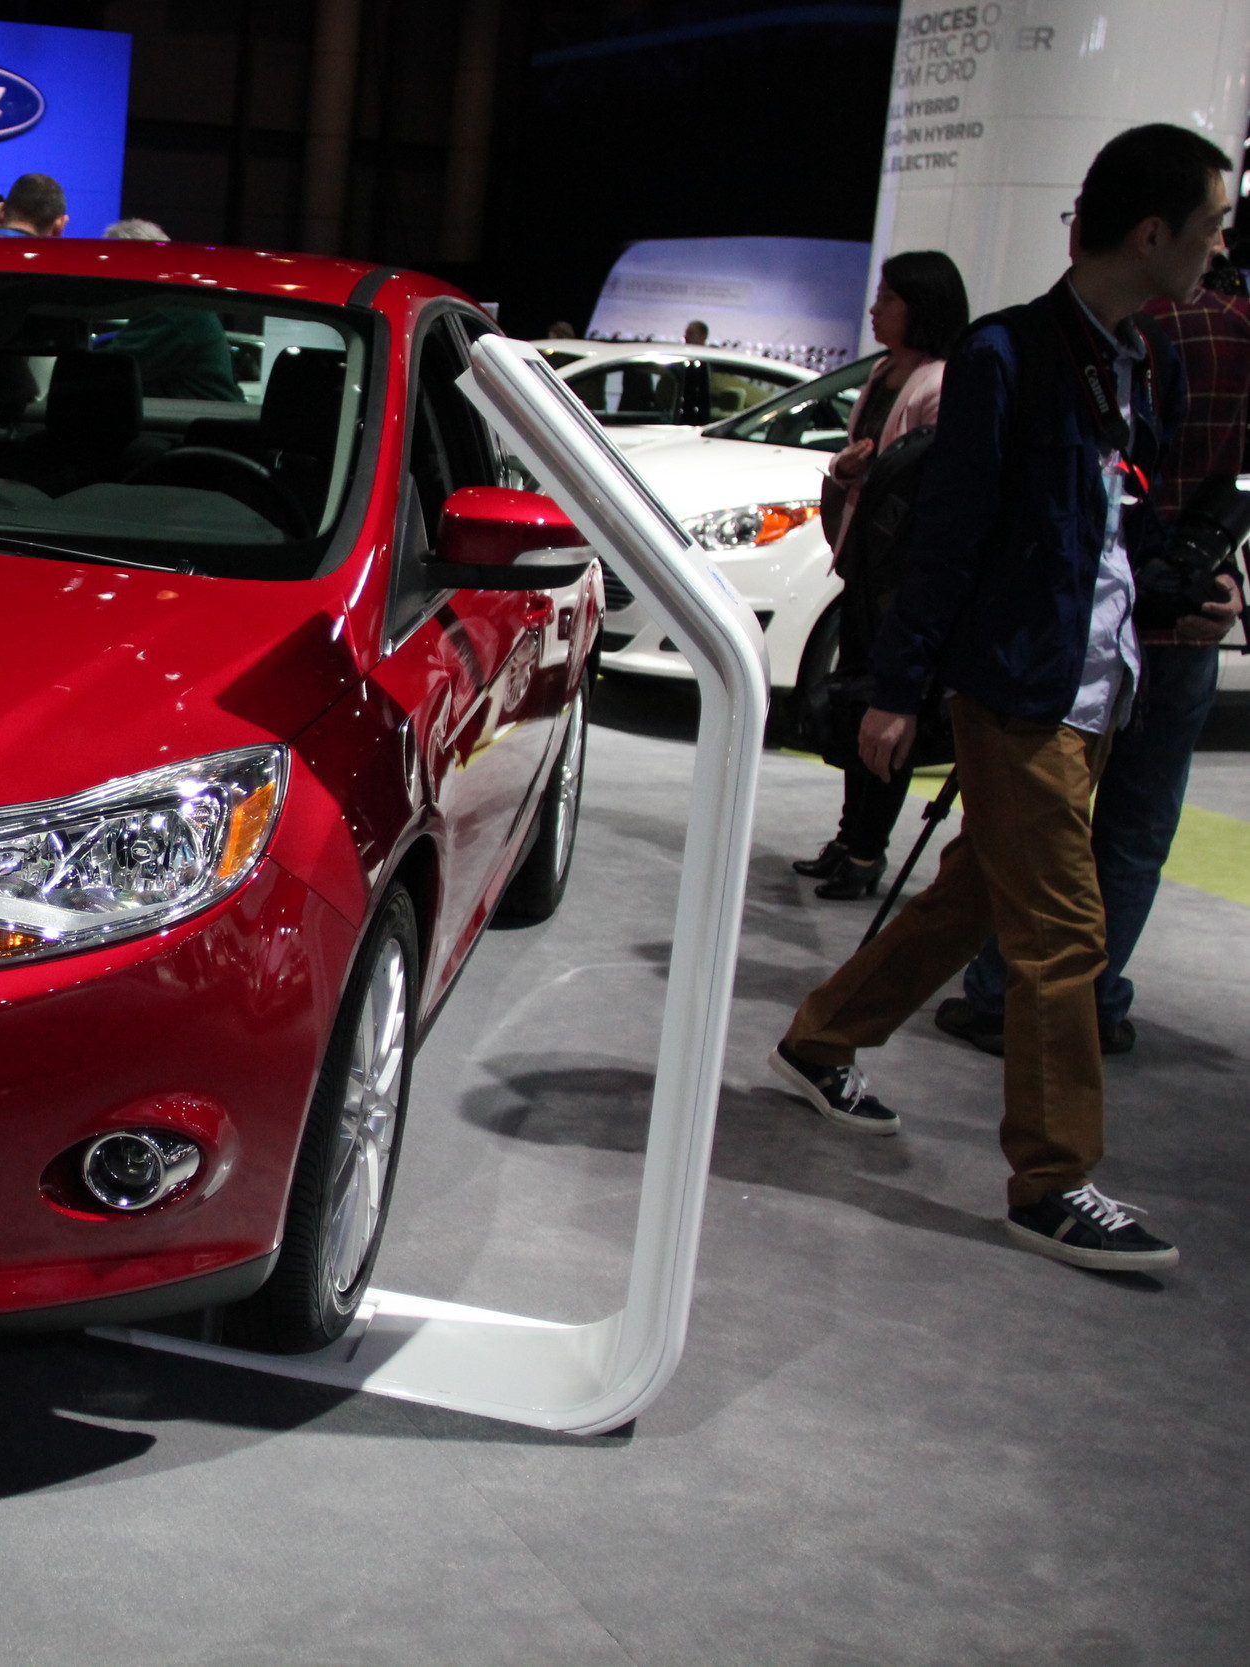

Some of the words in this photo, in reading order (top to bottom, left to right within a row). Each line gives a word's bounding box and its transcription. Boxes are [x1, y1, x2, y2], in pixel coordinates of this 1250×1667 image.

[902, 6, 977, 38] HOICES
[961, 26, 1055, 54] POER
[926, 57, 976, 87] FORD
[924, 121, 984, 142] HYBRID
[1085, 365, 1110, 413] Canon
